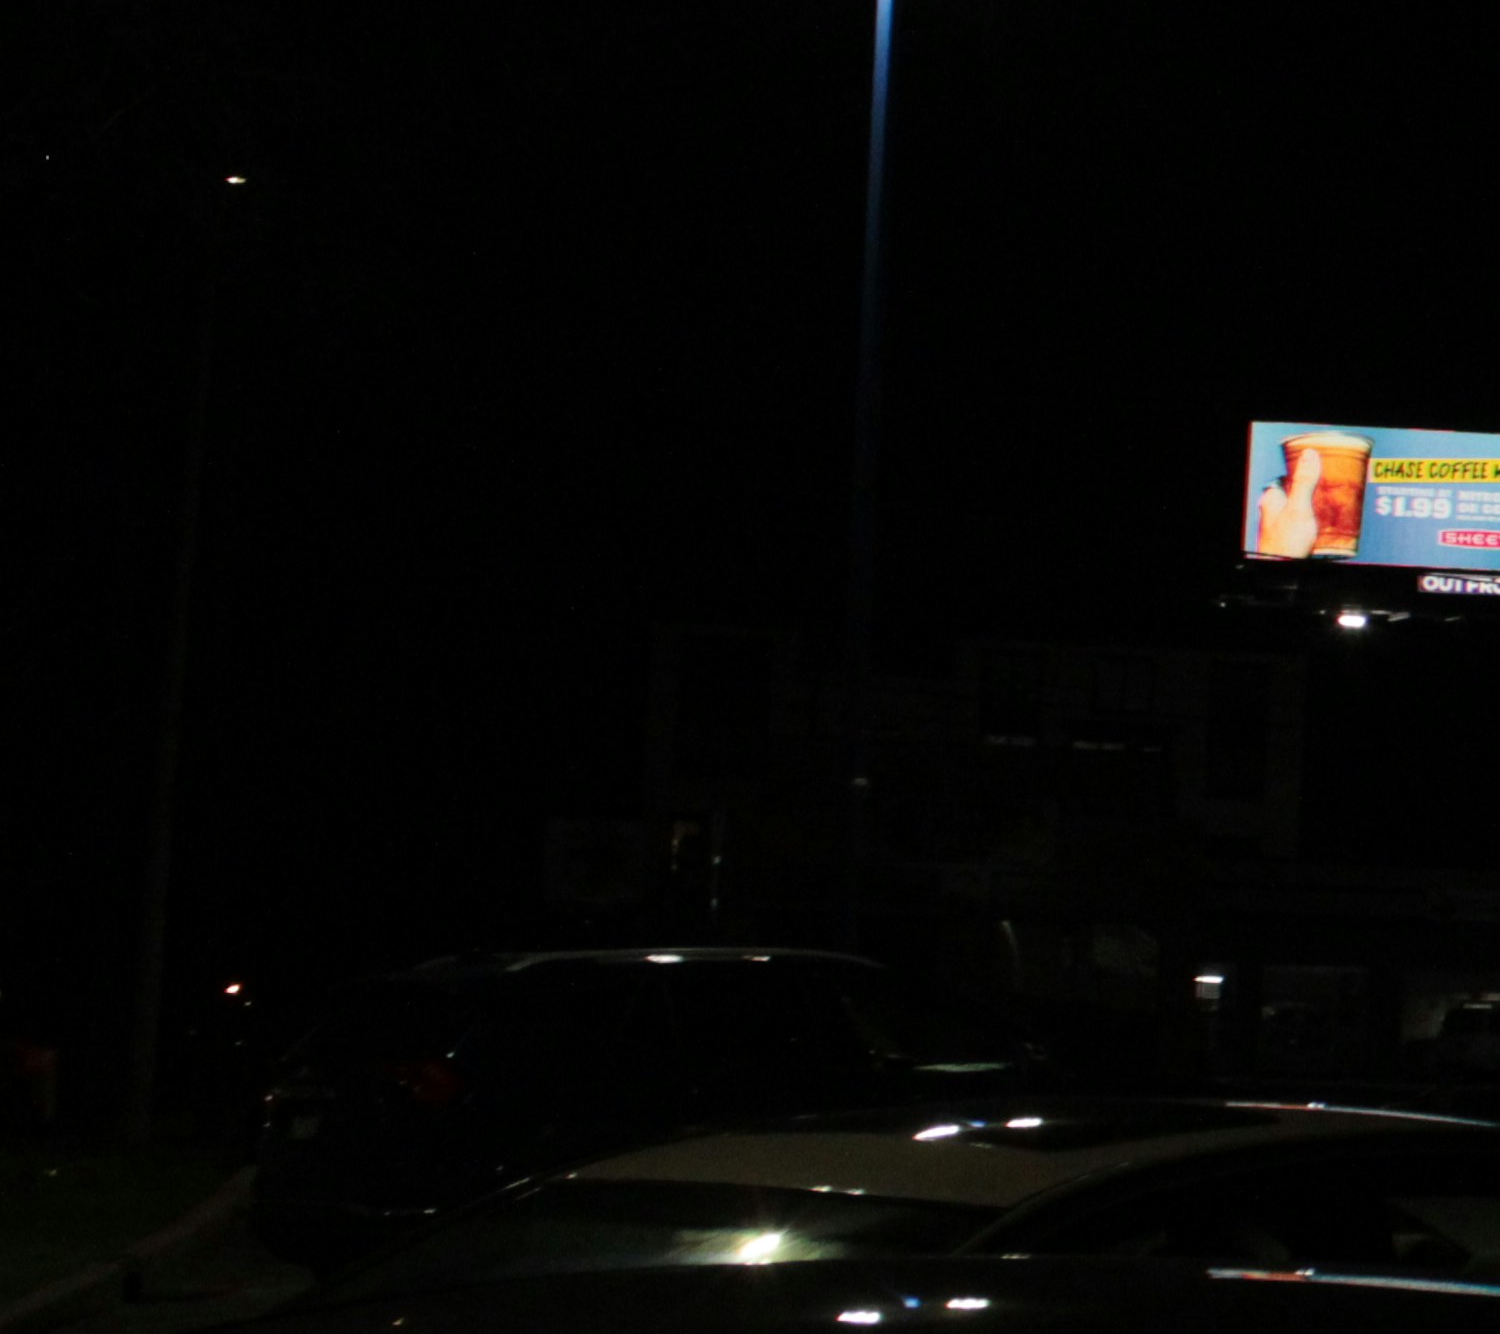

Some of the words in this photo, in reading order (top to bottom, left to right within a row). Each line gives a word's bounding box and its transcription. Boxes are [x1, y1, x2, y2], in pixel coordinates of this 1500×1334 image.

[1374, 461, 1424, 478] CHASE
[1428, 461, 1488, 479] COFFEE
[1375, 495, 1452, 519] $1.99
